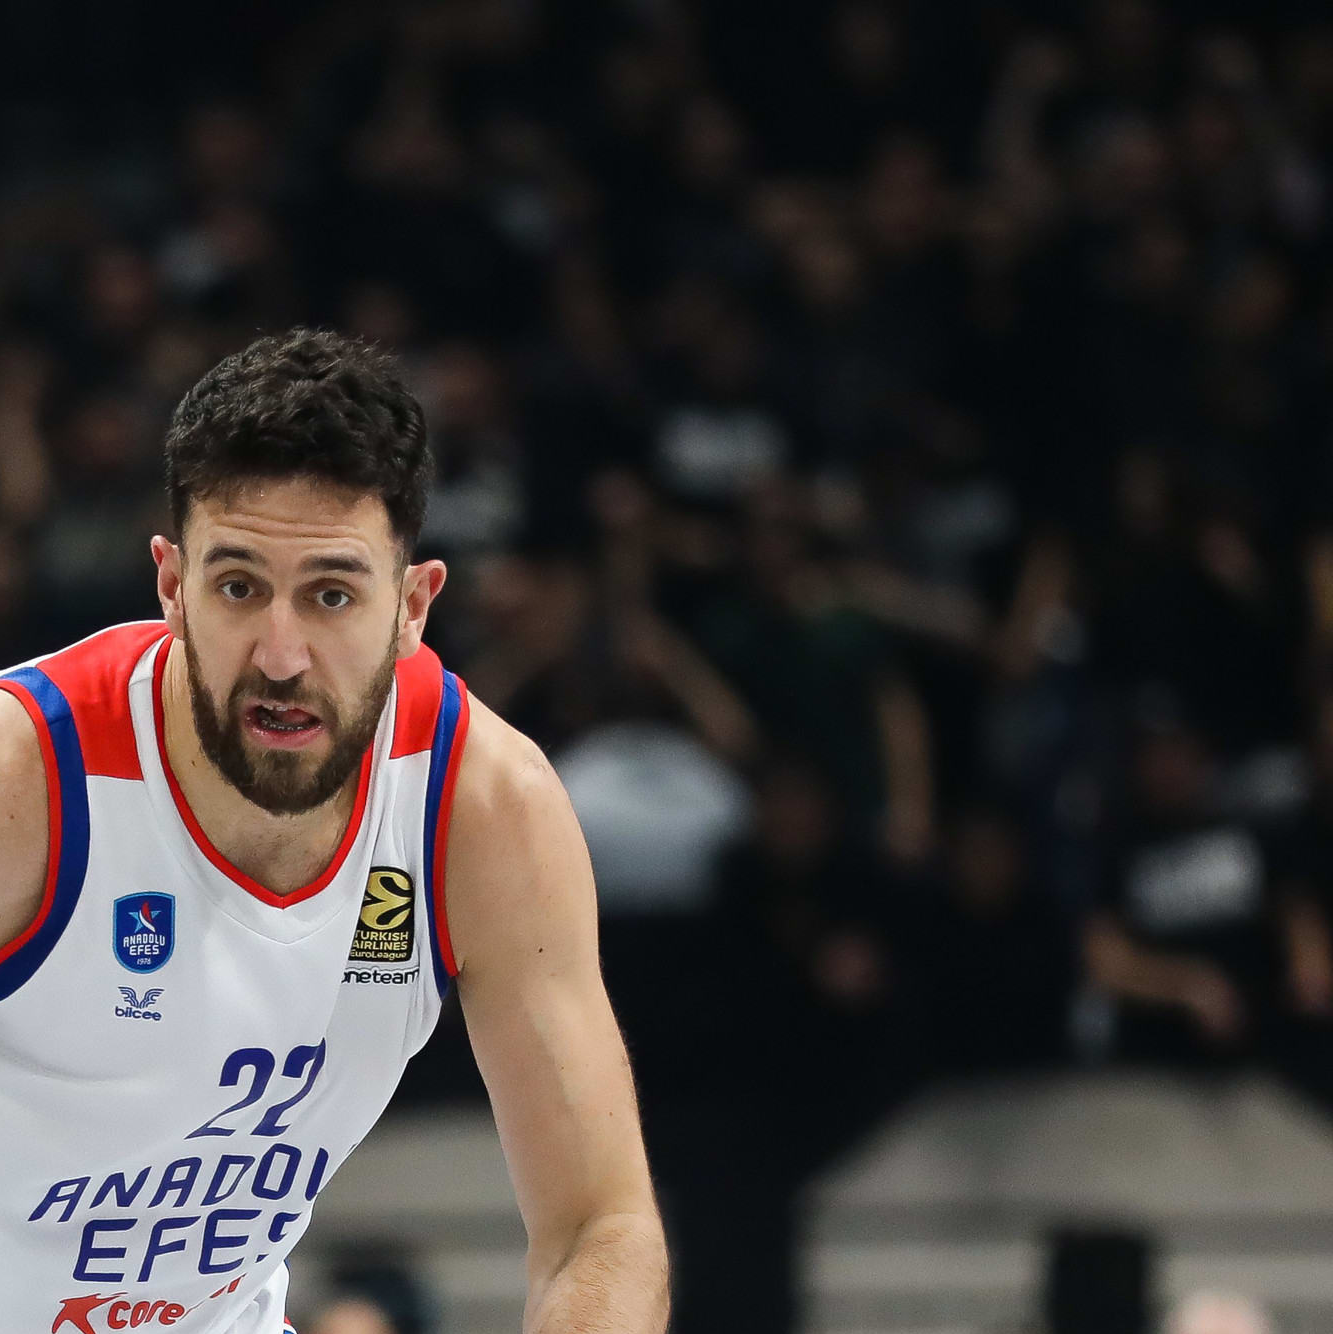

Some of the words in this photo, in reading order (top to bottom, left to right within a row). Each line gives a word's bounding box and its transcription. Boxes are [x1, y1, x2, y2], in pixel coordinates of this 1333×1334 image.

[123, 933, 166, 948] ANADOLU
[351, 940, 409, 951] AIRLINES
[129, 944, 161, 956] EFES
[115, 1006, 163, 1021] bilcee
[184, 1037, 327, 1140] 22
[27, 1142, 330, 1222] ANADOL
